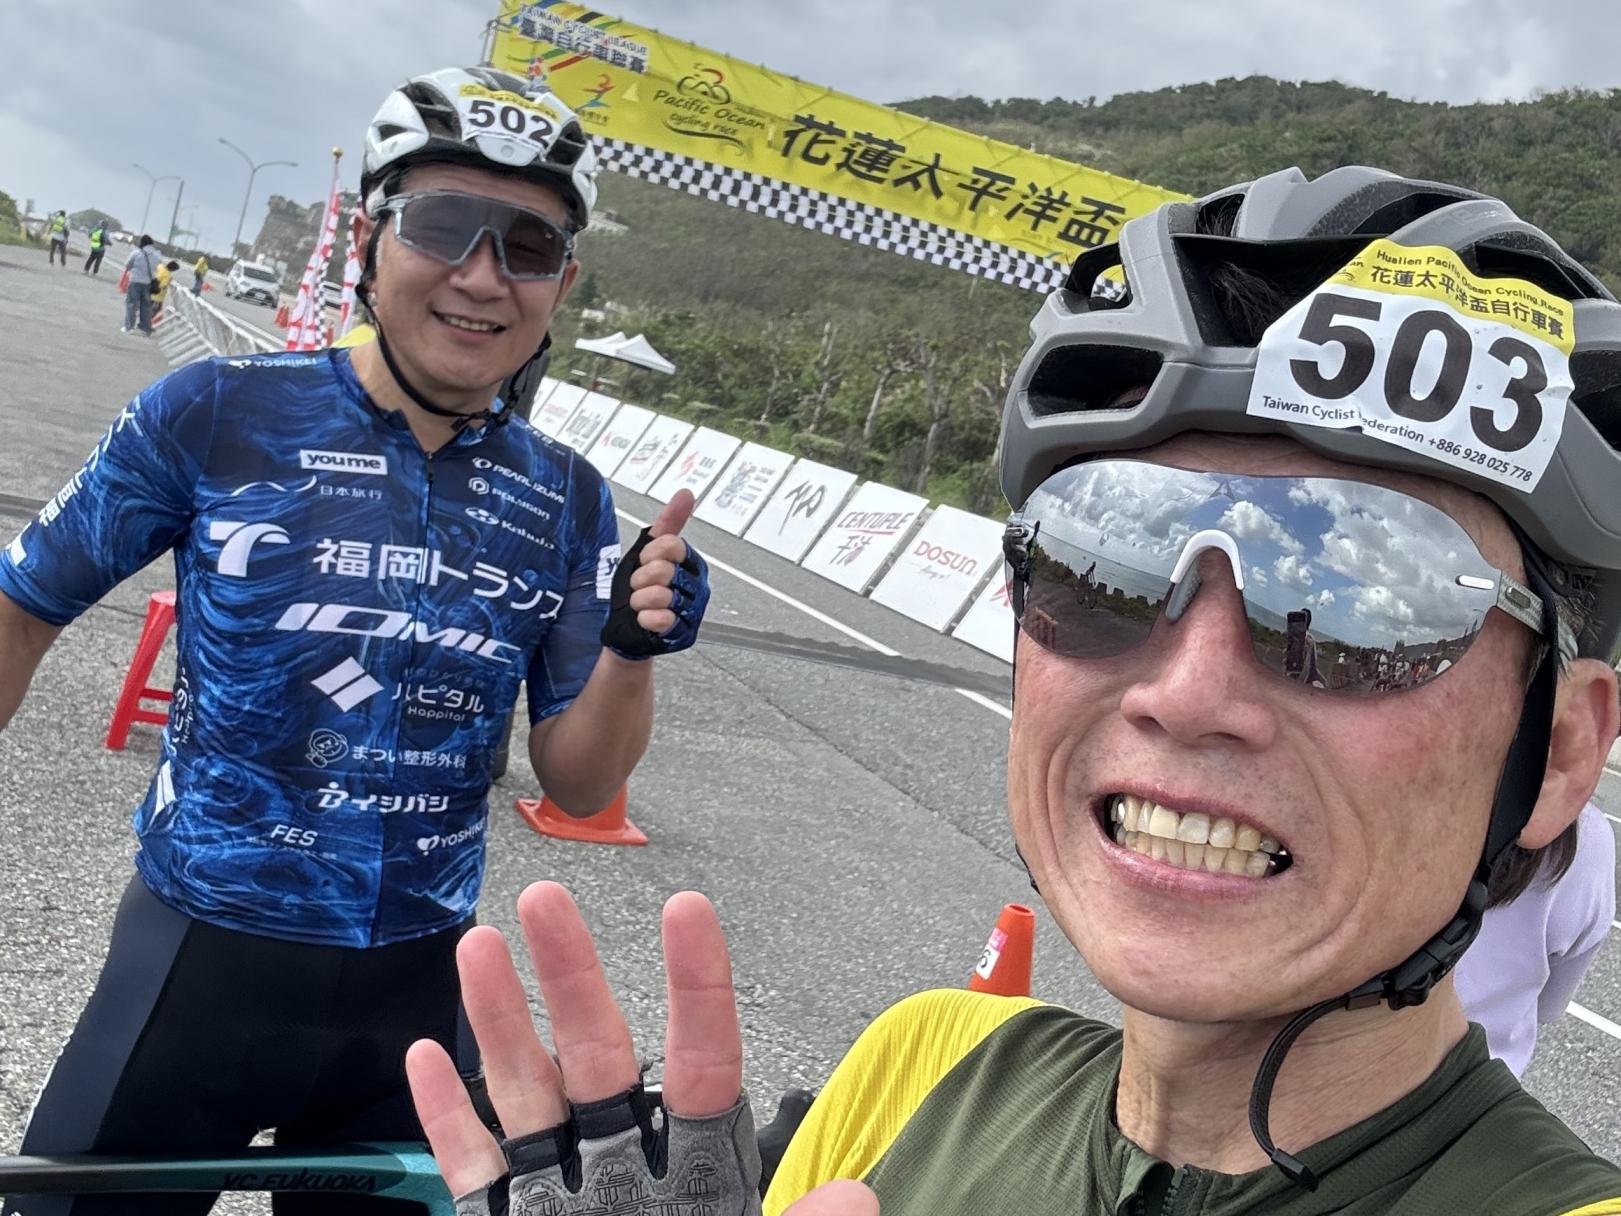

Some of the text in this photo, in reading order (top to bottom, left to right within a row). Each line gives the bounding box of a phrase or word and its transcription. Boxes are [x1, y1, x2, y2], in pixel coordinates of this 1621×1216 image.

[468, 99, 554, 150] 502
[652, 89, 766, 130] Pacific Ocean
[782, 113, 1127, 249] 花蓮太平洋盃
[1376, 249, 1423, 266] Hualien
[1495, 287, 1538, 305] Cycling
[1371, 265, 1565, 341] 花蓮太平洋盃自行車賽
[1289, 292, 1548, 453] 503
[1262, 395, 1310, 415] Taiwan
[1311, 405, 1356, 420] Cyclist
[1428, 437, 1463, 456] +886
[1462, 448, 1487, 465] 928
[1487, 457, 1510, 473] 025
[1509, 465, 1533, 482] 778
[307, 454, 382, 470] youme
[320, 485, 383, 501] 日本旅行
[493, 464, 565, 504] PEARL IZUMI
[313, 538, 565, 621] 福岡トランス
[391, 682, 485, 713] ハピタル
[408, 705, 466, 722] Happital
[353, 745, 467, 769] まつい整形外科
[270, 824, 319, 846] FES
[260, 1168, 376, 1192] FUKUOKA
